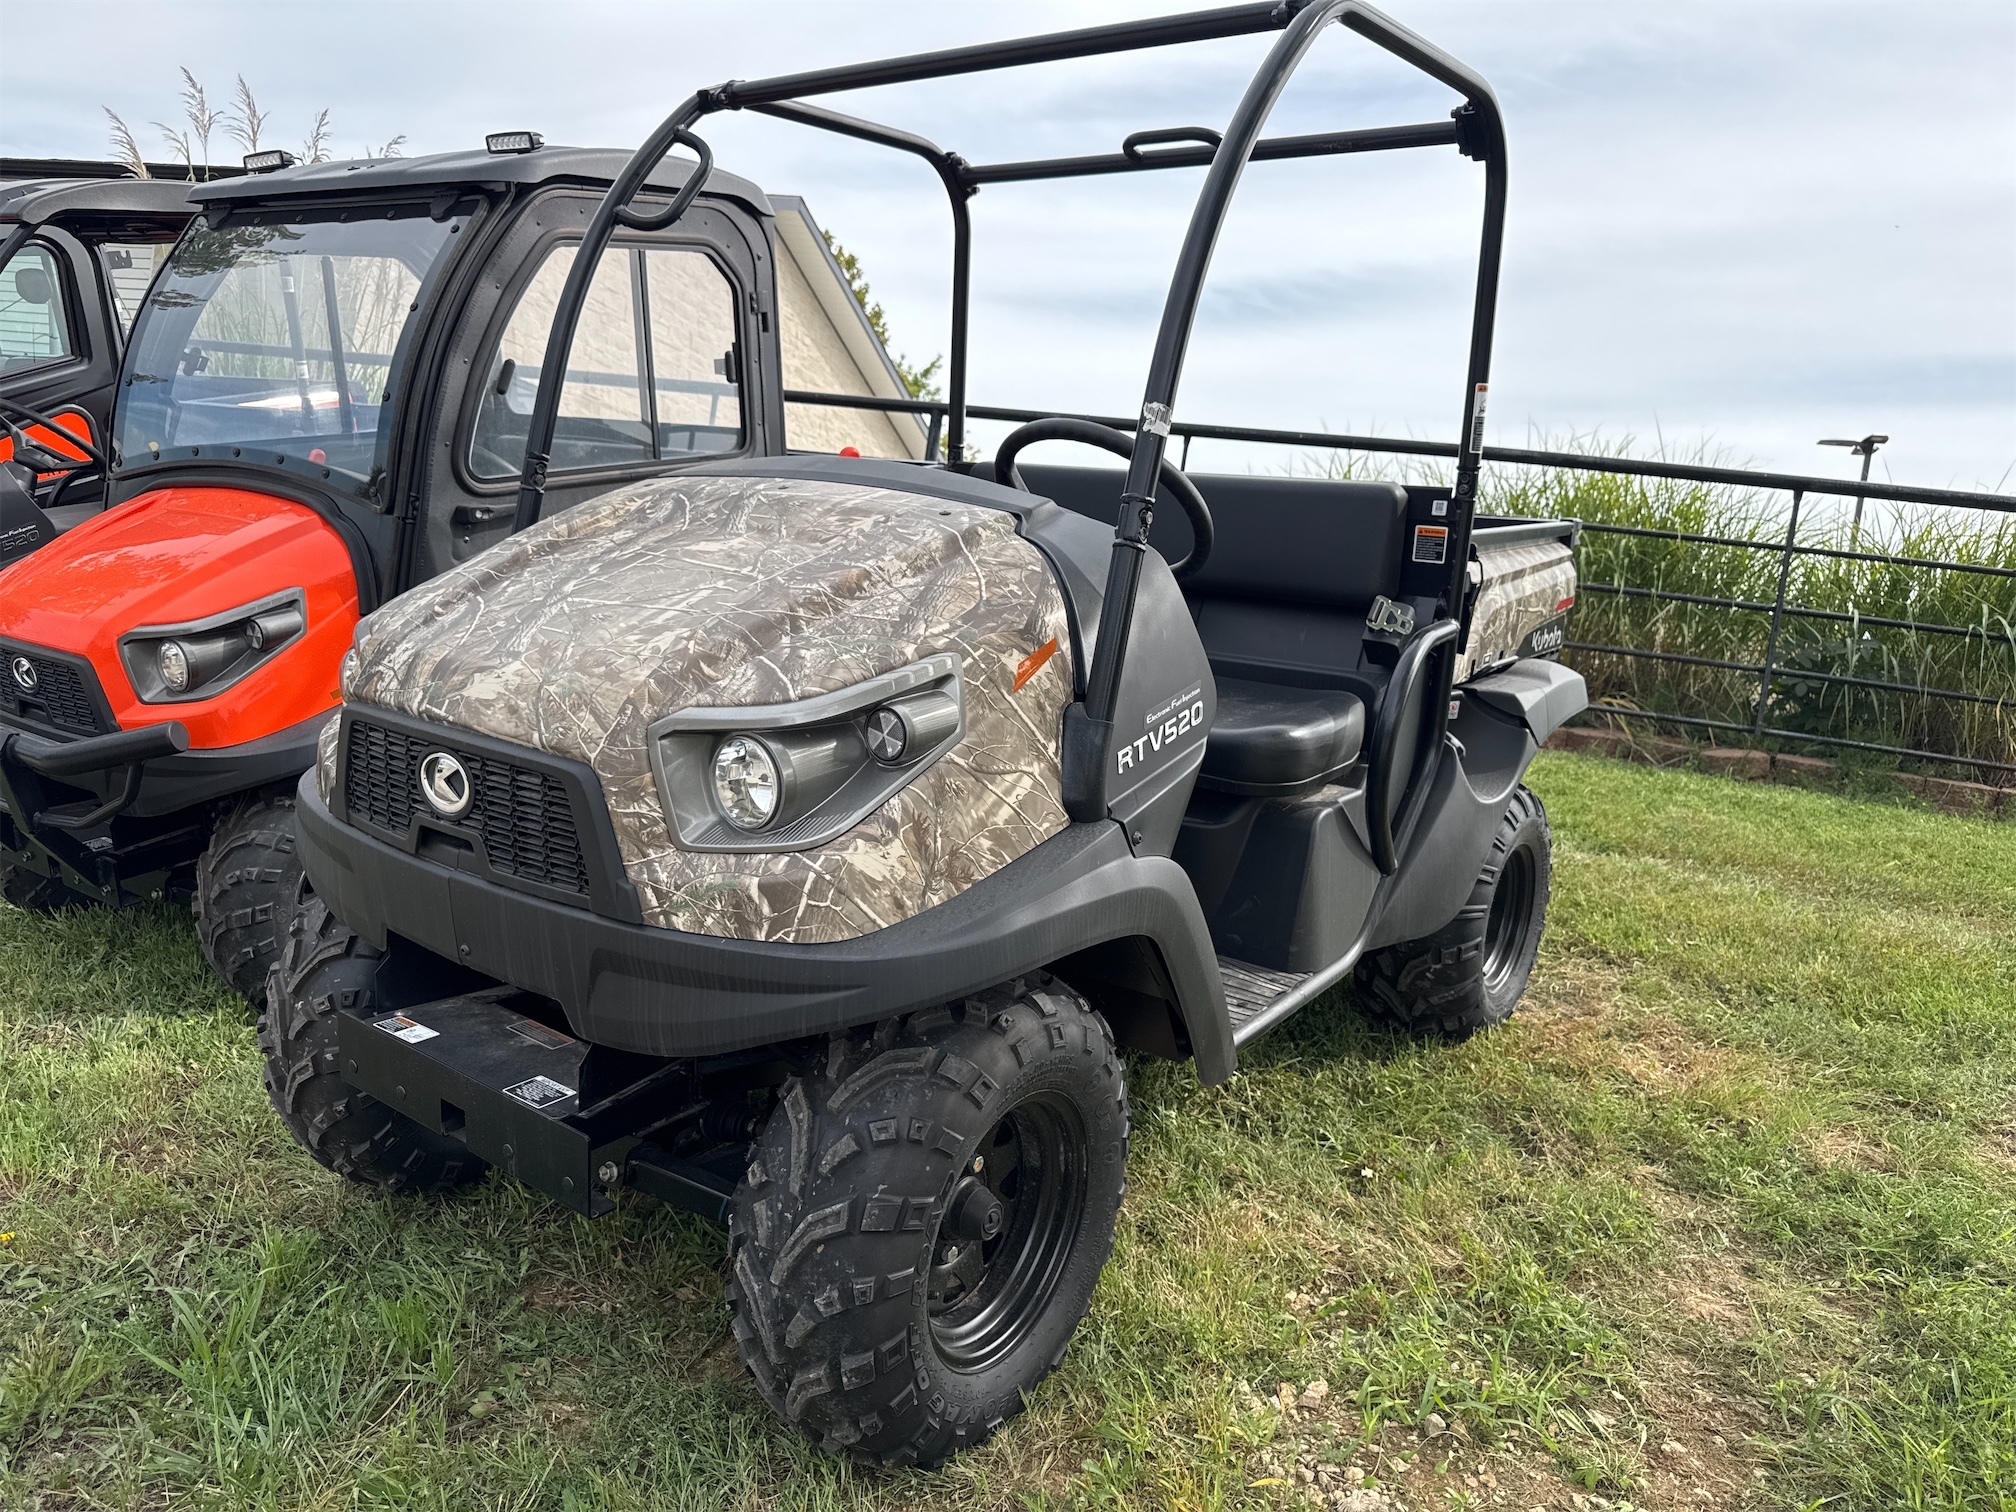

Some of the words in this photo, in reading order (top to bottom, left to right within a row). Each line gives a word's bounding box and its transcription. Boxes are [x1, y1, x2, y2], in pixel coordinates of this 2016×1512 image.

[0, 530, 40, 552] 520
[1531, 625, 1562, 652] Kubota
[1117, 700, 1204, 775] RTV520
[910, 1321, 931, 1391] OFF
